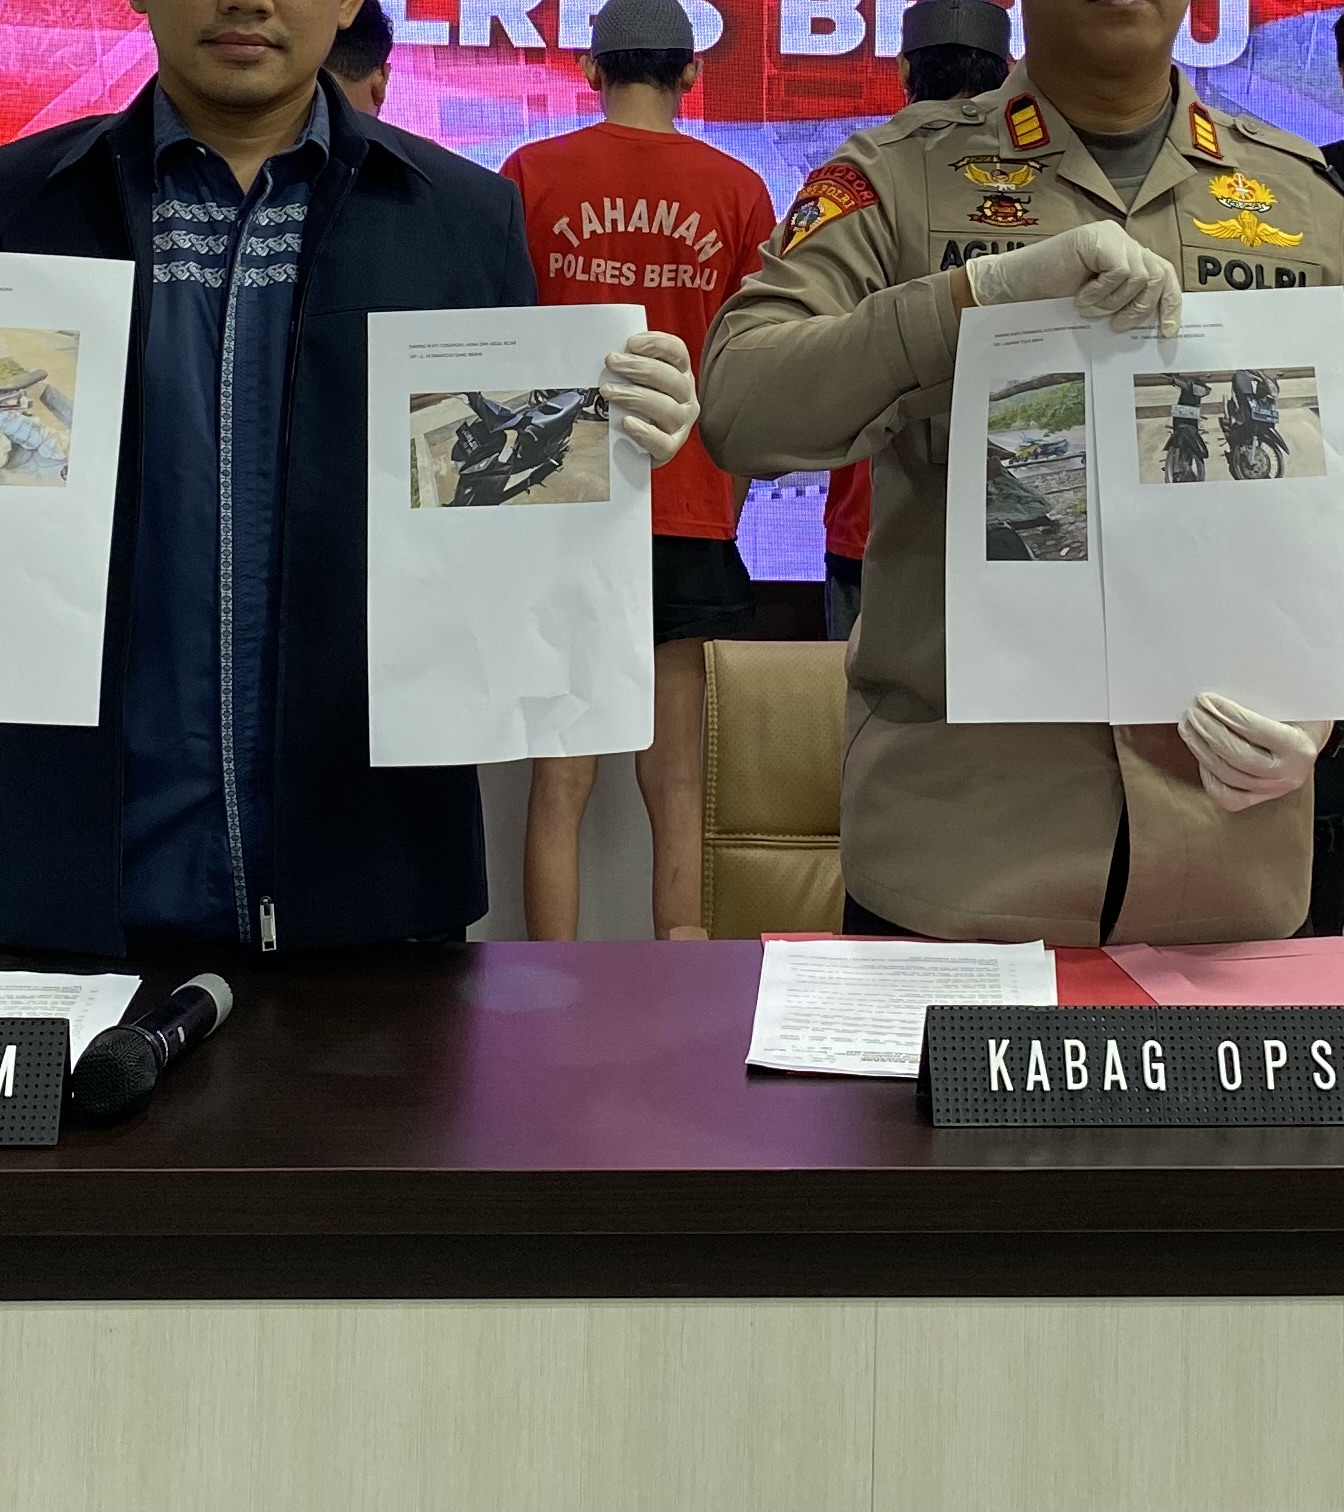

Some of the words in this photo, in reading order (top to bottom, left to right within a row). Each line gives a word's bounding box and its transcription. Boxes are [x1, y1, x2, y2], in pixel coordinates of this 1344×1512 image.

[552, 197, 723, 263] TAHANAN
[549, 252, 636, 286] POLRES
[988, 1039, 1167, 1092] KABAG
[1217, 1039, 1337, 1091] OPS
